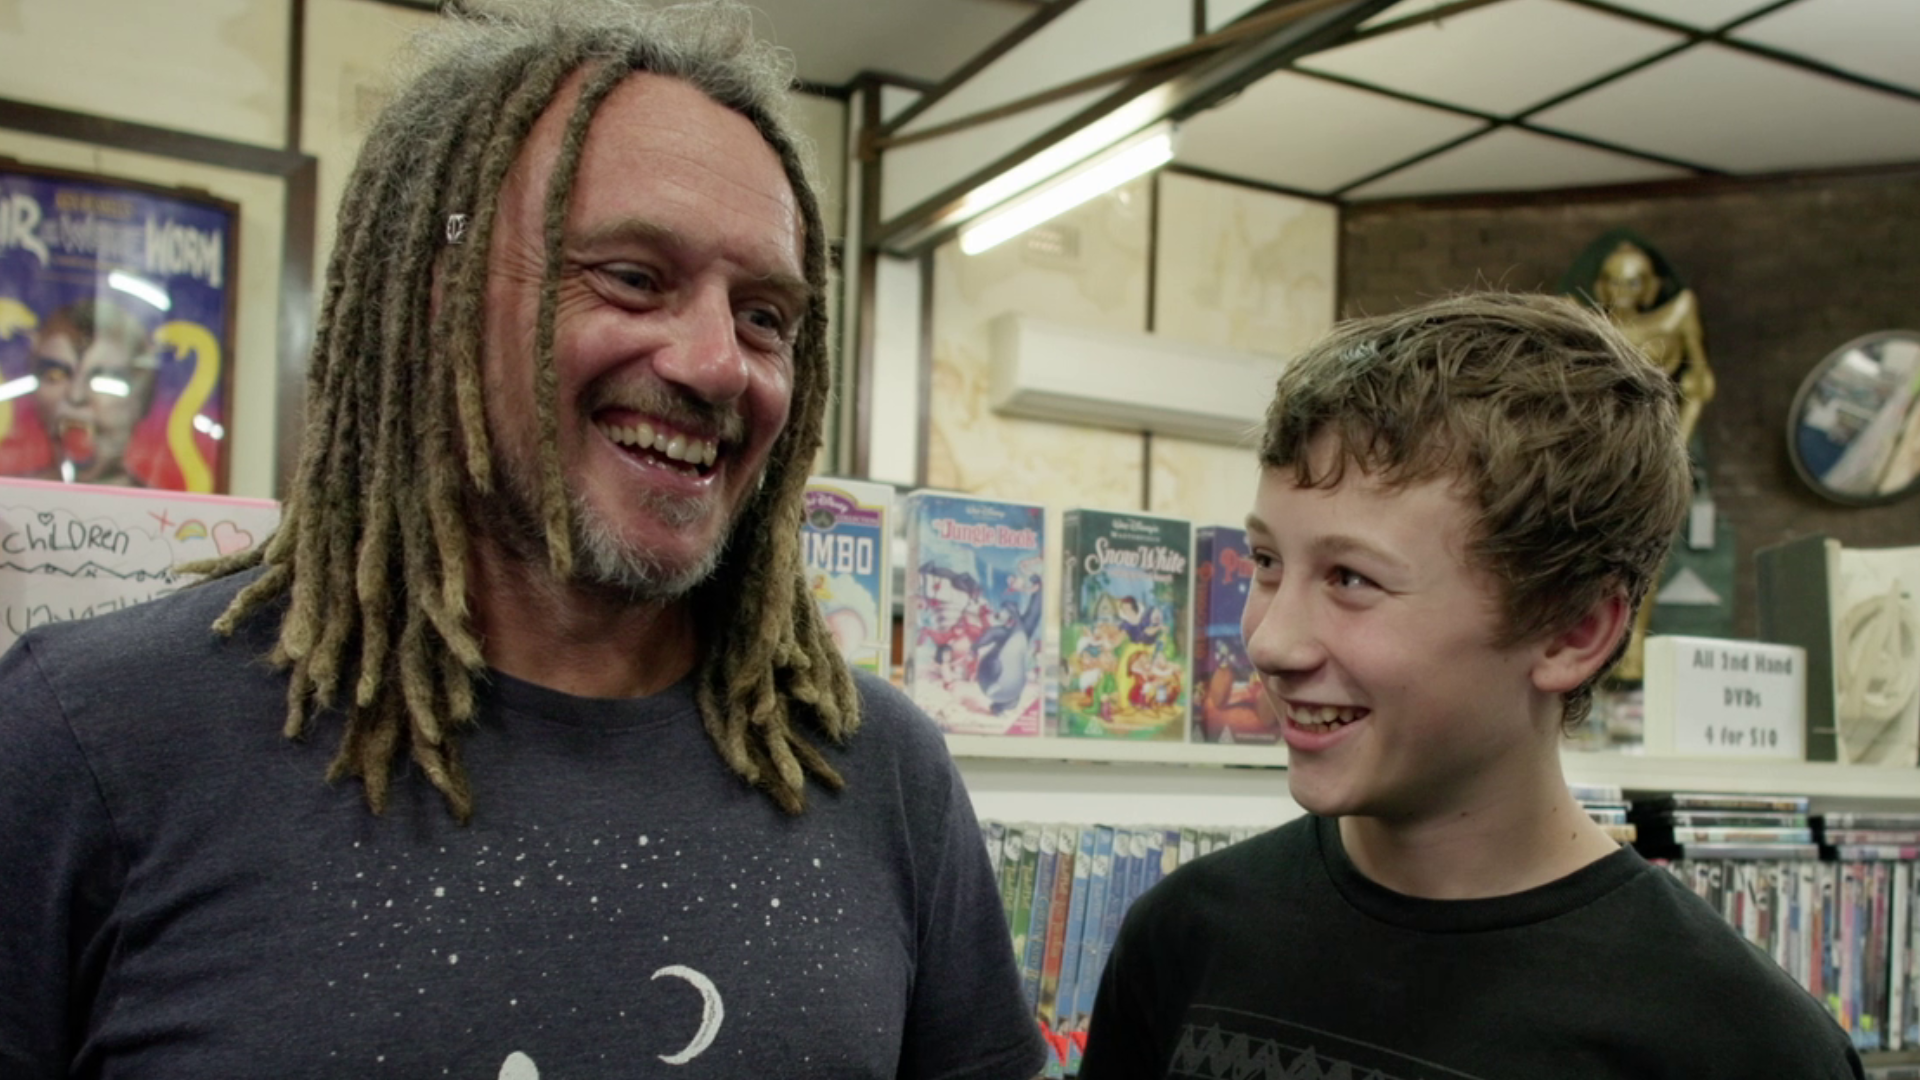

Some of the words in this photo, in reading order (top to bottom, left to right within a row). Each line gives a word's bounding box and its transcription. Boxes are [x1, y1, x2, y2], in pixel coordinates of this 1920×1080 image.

[145, 210, 223, 290] WORM
[941, 519, 995, 548] Jungle
[995, 524, 1038, 550] Book
[1084, 536, 1139, 575] Snow
[1138, 545, 1186, 575] White
[1693, 649, 1714, 668] All
[1722, 651, 1748, 671] 2nd
[1755, 653, 1792, 675] Hand
[1723, 686, 1762, 708] DVDs
[1704, 725, 1715, 745] 4
[1720, 726, 1744, 746] for
